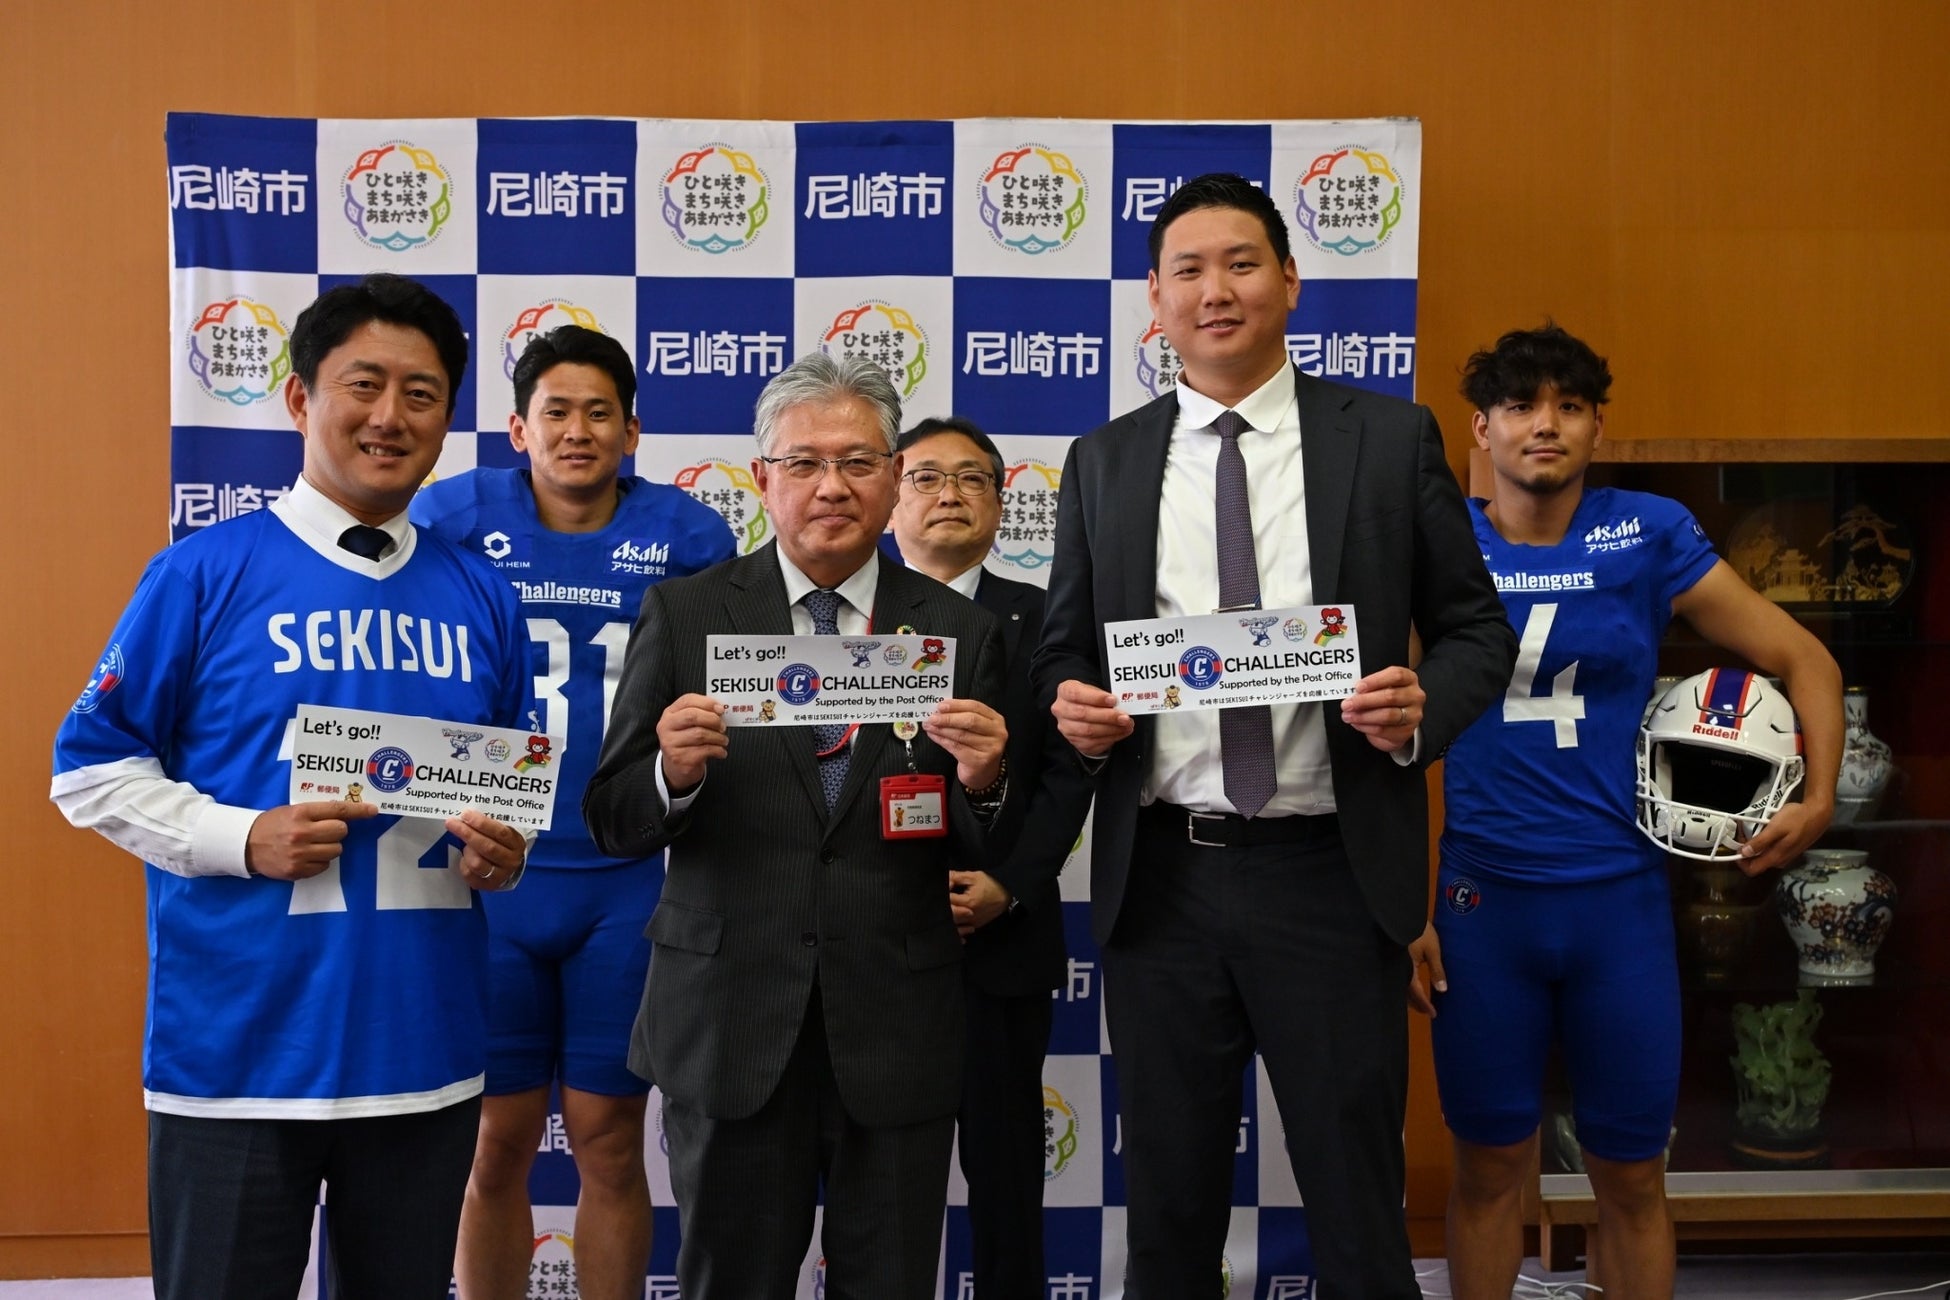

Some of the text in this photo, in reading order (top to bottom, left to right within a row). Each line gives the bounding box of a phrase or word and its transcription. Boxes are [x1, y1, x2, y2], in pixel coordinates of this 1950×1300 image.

[365, 172, 429, 188] ひと咲き
[684, 174, 747, 192] ひと咲き
[1001, 175, 1064, 192] ひと咲き
[1318, 175, 1380, 193] ひと咲き
[171, 164, 308, 216] 尼崎市
[365, 190, 429, 207] まち咲き
[486, 171, 628, 218] 尼崎市
[804, 172, 946, 219] 尼崎市
[684, 192, 747, 209] まち咲き
[1001, 193, 1064, 210] まち咲き
[1318, 194, 1380, 211] まち咲き
[365, 208, 429, 224] あまがさき
[684, 210, 747, 227] あまがさき
[1001, 211, 1064, 227] あまがさき
[1318, 212, 1380, 228] あまがさき
[211, 325, 269, 343] ひと咲き
[843, 330, 904, 348] ひと咲き
[211, 343, 269, 361] まち咲き
[646, 331, 787, 377] 尼崎市
[962, 331, 1103, 378] 尼崎市
[211, 360, 269, 378] あまがさき
[171, 483, 290, 527] 尼崎
[1584, 516, 1641, 543] Asahi
[612, 540, 669, 563] Asahi
[1586, 537, 1643, 554] アサヒ飲料
[611, 561, 666, 576] アサヒ飲料
[1490, 571, 1594, 591] hallengers
[268, 609, 472, 683] SEKISUI
[1113, 629, 1184, 649] Let's go!!
[714, 646, 786, 662] Let's go!!
[1113, 649, 1355, 682] SEKISUI CHALLENGERS
[1193, 657, 1207, 676] C
[711, 675, 949, 694] SEKISUI CHALLENGERS
[791, 674, 806, 691] C
[1219, 671, 1353, 690] Supported by the Post Office
[1503, 603, 1586, 749] 4
[526, 618, 631, 753] 31
[815, 694, 945, 707] Supported by the Post Office
[1136, 691, 1159, 701] 郵便局
[732, 704, 754, 713] 郵便局
[303, 717, 381, 740] Let's go!!
[1692, 724, 1739, 741] Riddell
[296, 753, 552, 794] SEKISUI CHALLENGERS
[382, 759, 399, 777] C
[317, 785, 340, 794] 郵便局
[405, 787, 545, 811] Supported by the Post Office
[907, 814, 941, 825] つねまつ
